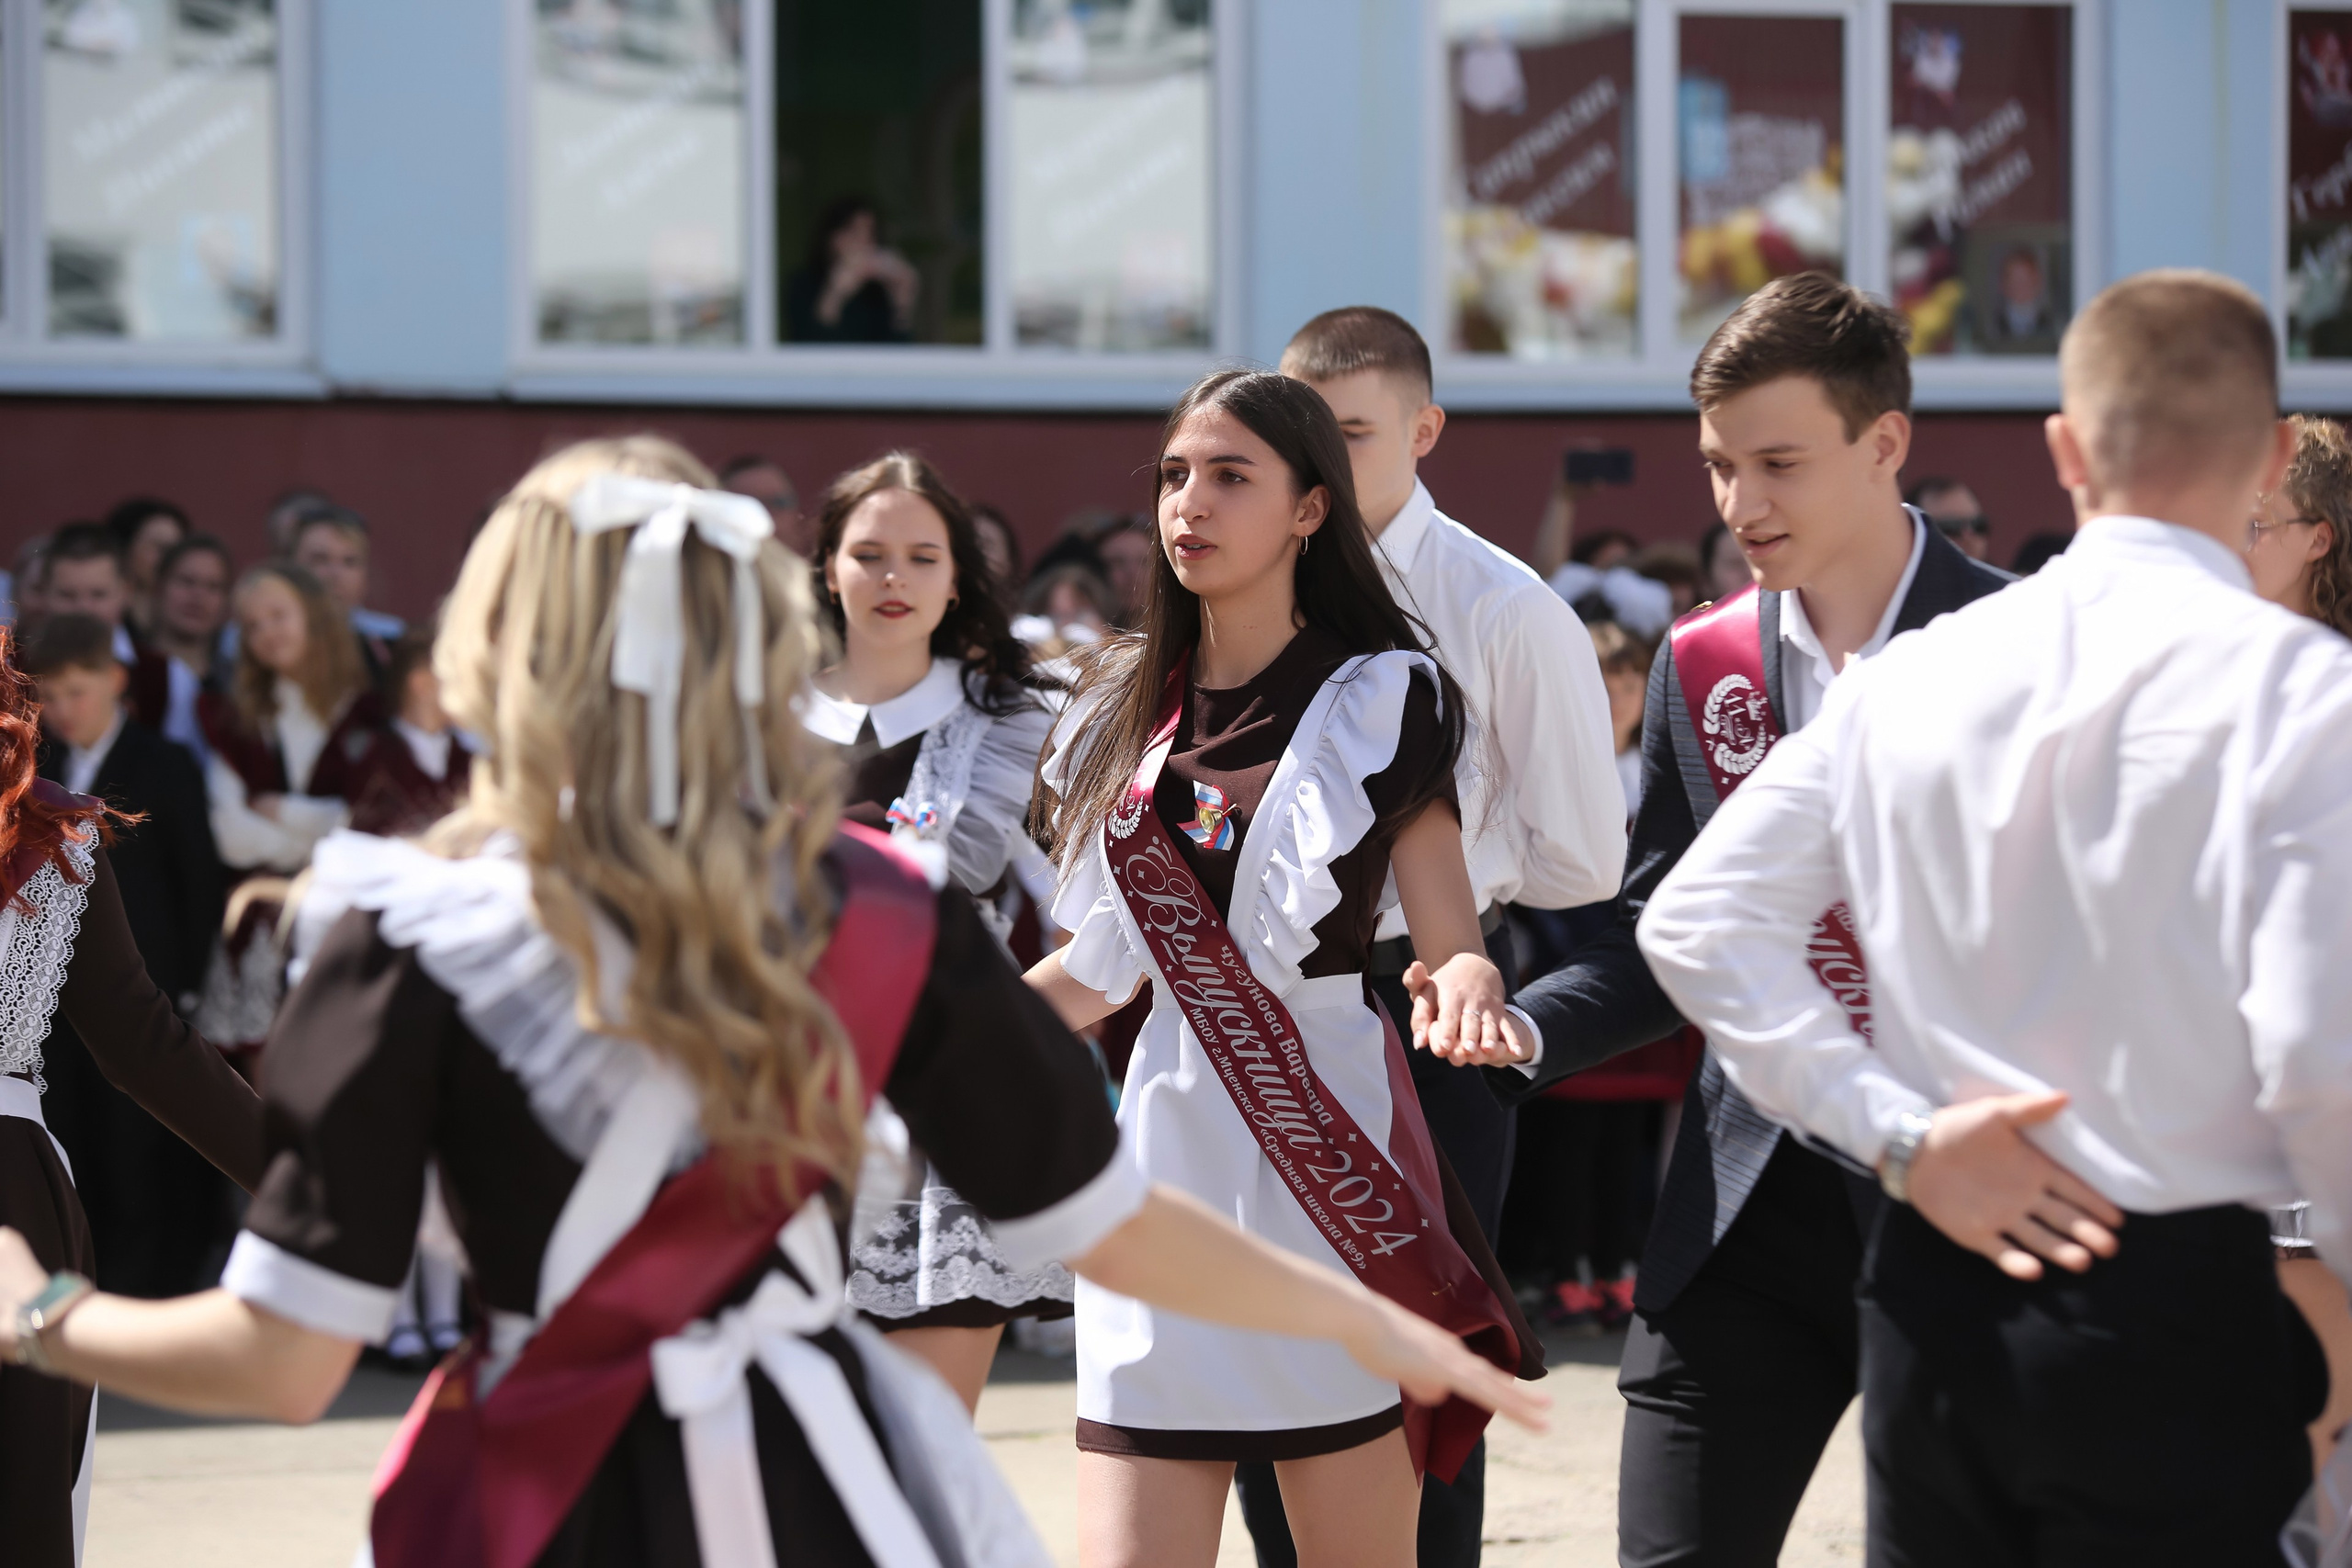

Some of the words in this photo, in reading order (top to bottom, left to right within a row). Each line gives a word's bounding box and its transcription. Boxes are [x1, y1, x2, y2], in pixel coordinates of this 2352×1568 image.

[1126, 840, 1324, 1152] Выпускница
[1304, 1150, 1419, 1257] 2024
[1189, 1007, 1220, 1044] МБОУ
[1211, 1046, 1256, 1113] г.Мценска
[1260, 1128, 1308, 1195] «Средняя
[1304, 1193, 1343, 1240] школа
[1338, 1238, 1367, 1270] №9»
[1221, 943, 1284, 1038] Чугунова
[1278, 1036, 1334, 1126] Варвара
